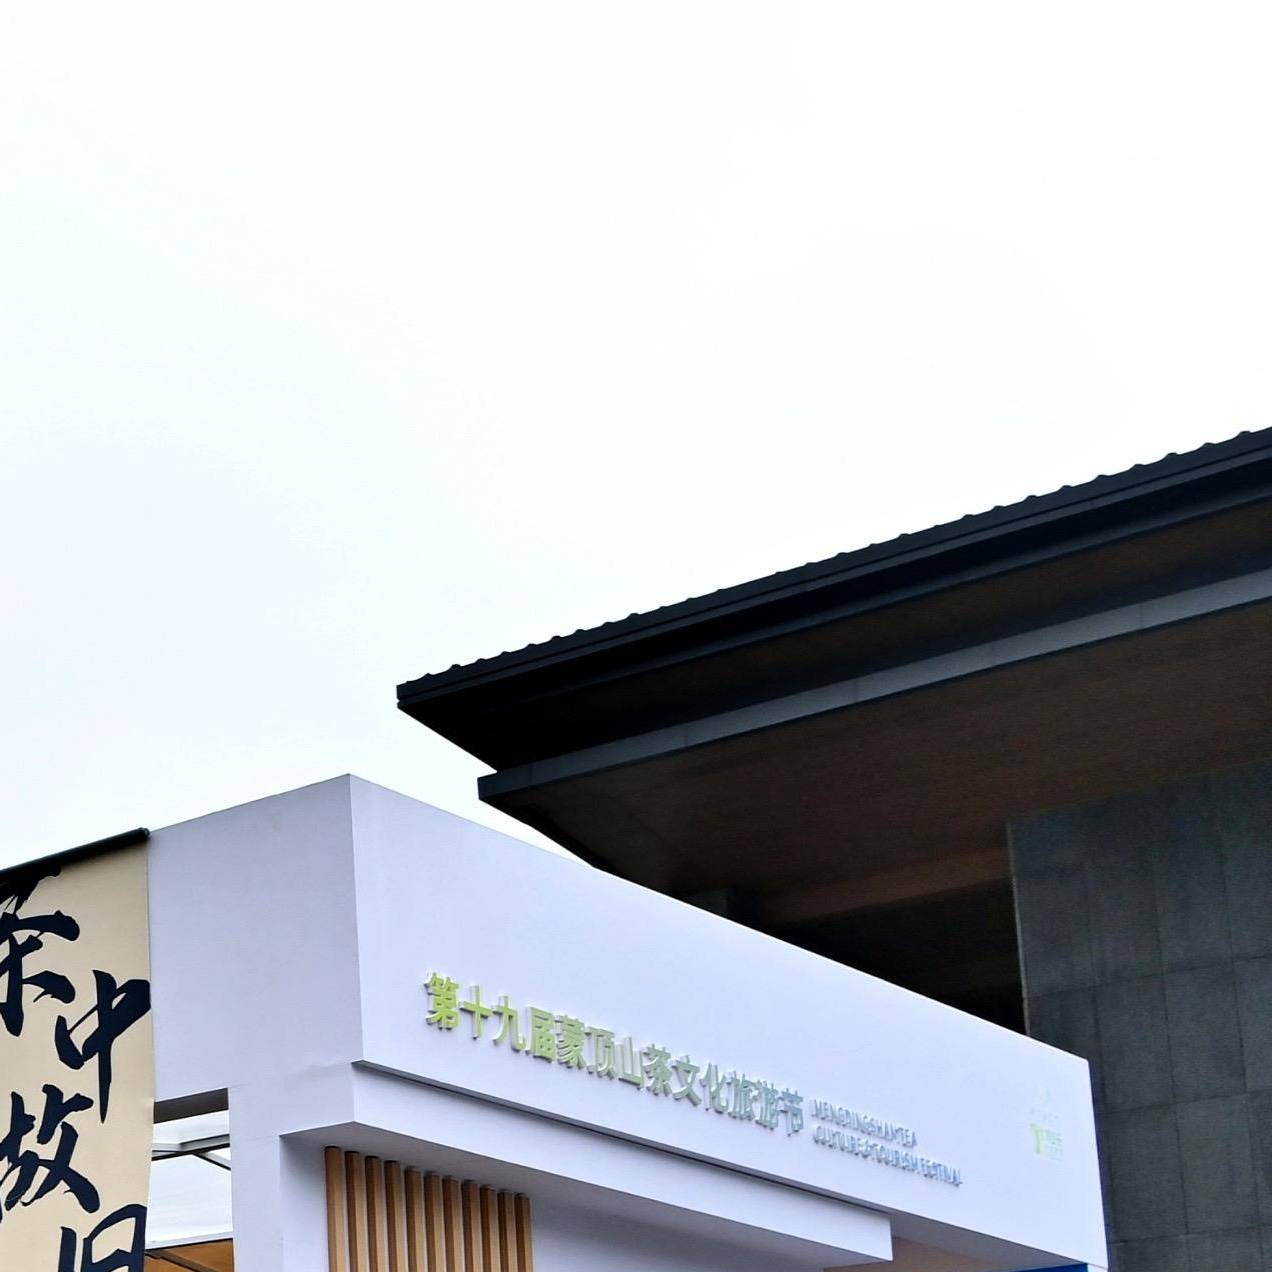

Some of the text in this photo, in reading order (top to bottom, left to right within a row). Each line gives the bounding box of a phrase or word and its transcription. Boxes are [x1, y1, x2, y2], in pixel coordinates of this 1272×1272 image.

[424, 972, 804, 1136] 第十九届蒙顶山茶文化旅游节
